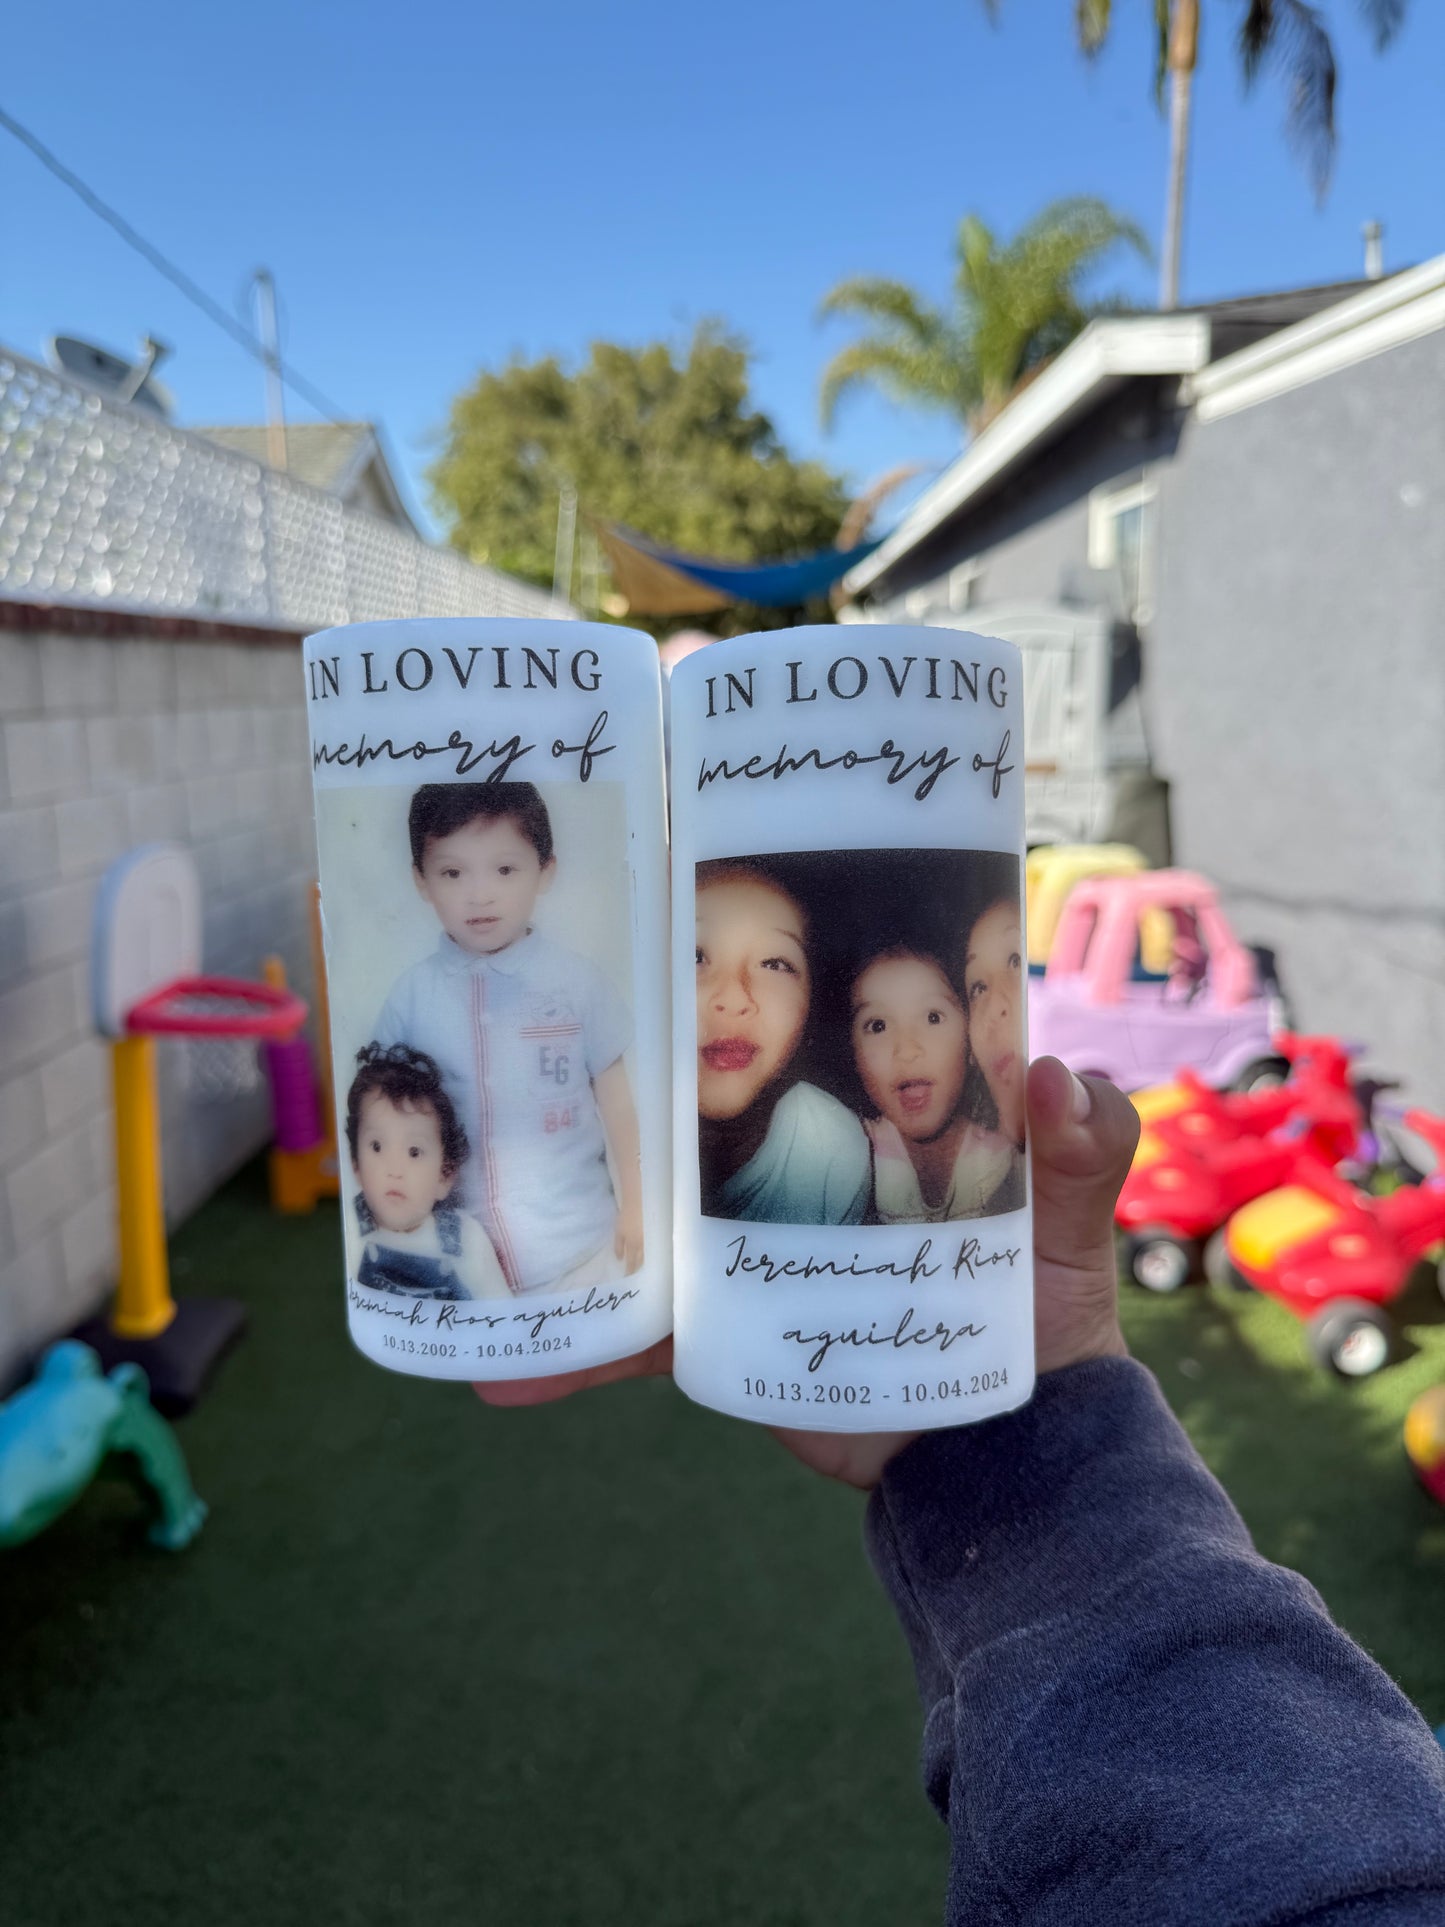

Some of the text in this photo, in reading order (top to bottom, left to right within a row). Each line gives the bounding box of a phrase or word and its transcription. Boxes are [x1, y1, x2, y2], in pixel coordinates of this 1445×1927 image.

[309, 647, 603, 701] IN LOVING
[705, 656, 1008, 718] IN LOVING
[313, 710, 617, 784] memory of
[697, 729, 1015, 801] memory of
[726, 1235, 1021, 1283] Jeremiah Rios
[436, 1304, 506, 1331] Rios
[512, 1287, 640, 1338] aguilera
[382, 1334, 457, 1357] 10.13.2002
[477, 1336, 572, 1357] 10.04.2024
[783, 1308, 987, 1372] aguilera
[744, 1377, 871, 1404] 10.13.2002
[902, 1368, 1008, 1403] 10.04.2024
